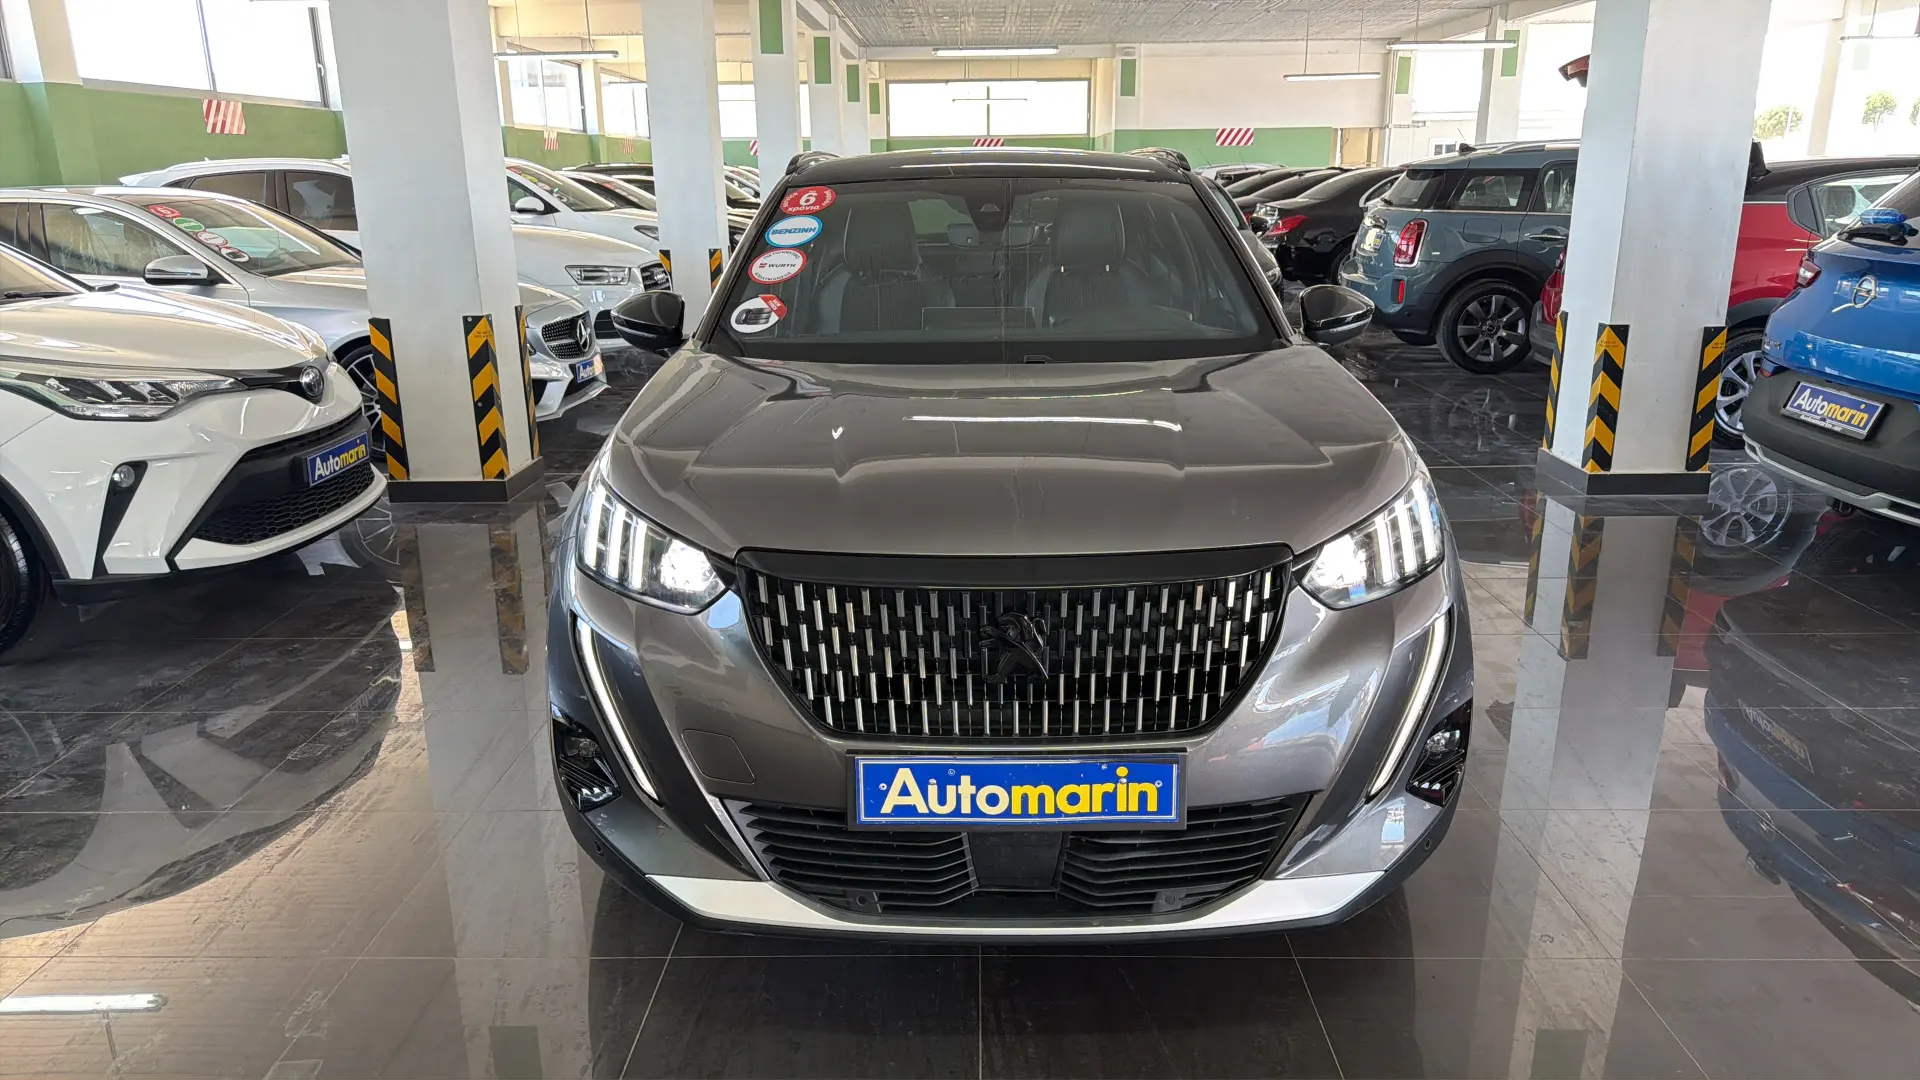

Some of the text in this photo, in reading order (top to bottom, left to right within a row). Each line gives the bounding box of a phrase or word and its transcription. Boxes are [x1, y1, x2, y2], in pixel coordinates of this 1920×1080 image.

[799, 192, 818, 206] 6
[1793, 388, 1868, 427] Automarin
[315, 439, 366, 480] Automarin
[880, 766, 1158, 815] Automarin
